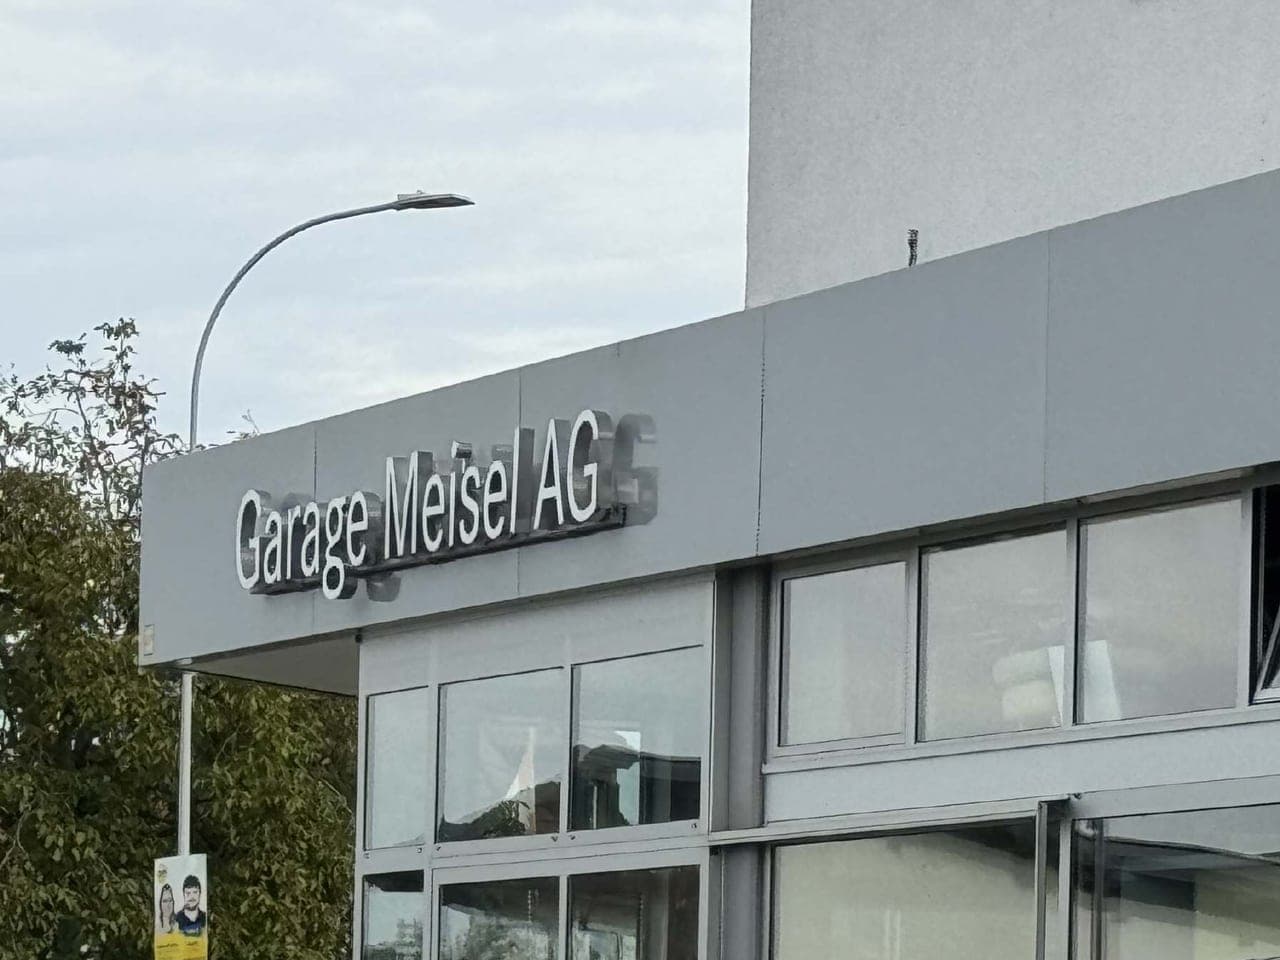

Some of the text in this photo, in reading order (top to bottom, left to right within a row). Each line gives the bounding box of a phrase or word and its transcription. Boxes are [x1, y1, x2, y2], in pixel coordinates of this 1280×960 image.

[236, 408, 600, 600] Garage Meisel AG
